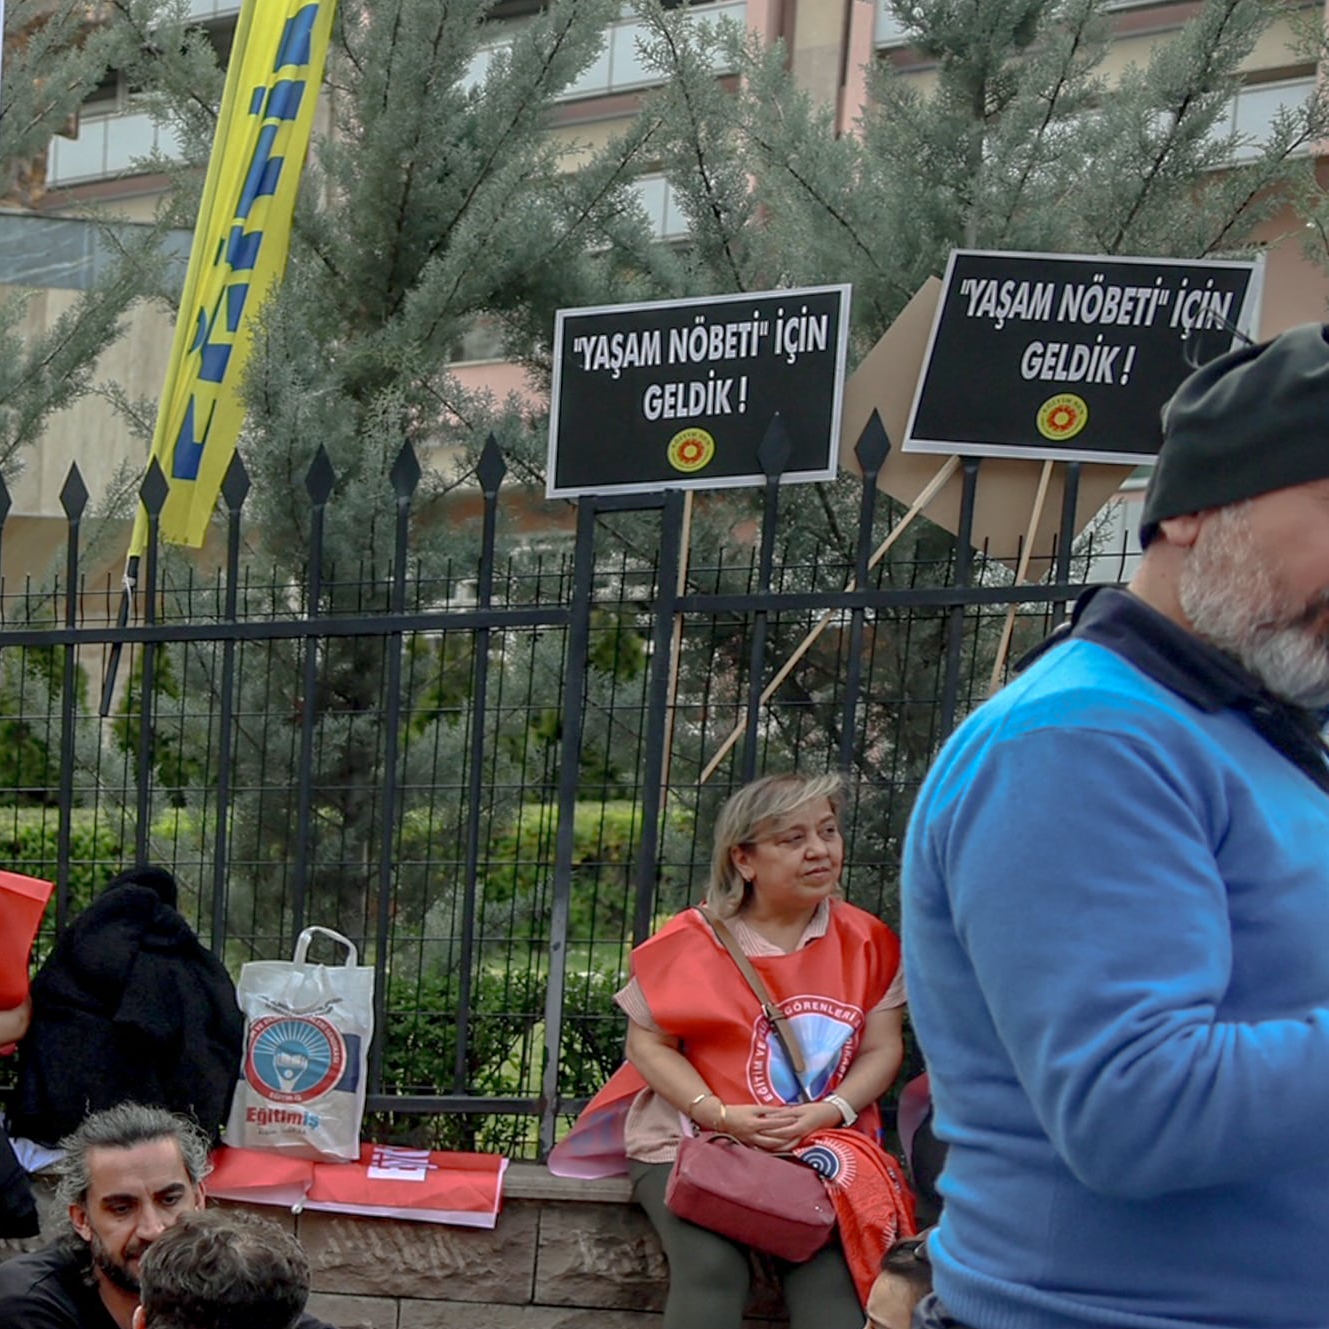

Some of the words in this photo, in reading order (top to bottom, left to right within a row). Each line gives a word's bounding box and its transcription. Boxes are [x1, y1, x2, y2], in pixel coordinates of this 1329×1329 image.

[774, 305, 829, 365] İÇİN
[1169, 277, 1235, 340] İÇİN
[1021, 333, 1121, 385] GELDİK
[643, 369, 734, 421] GELDİK
